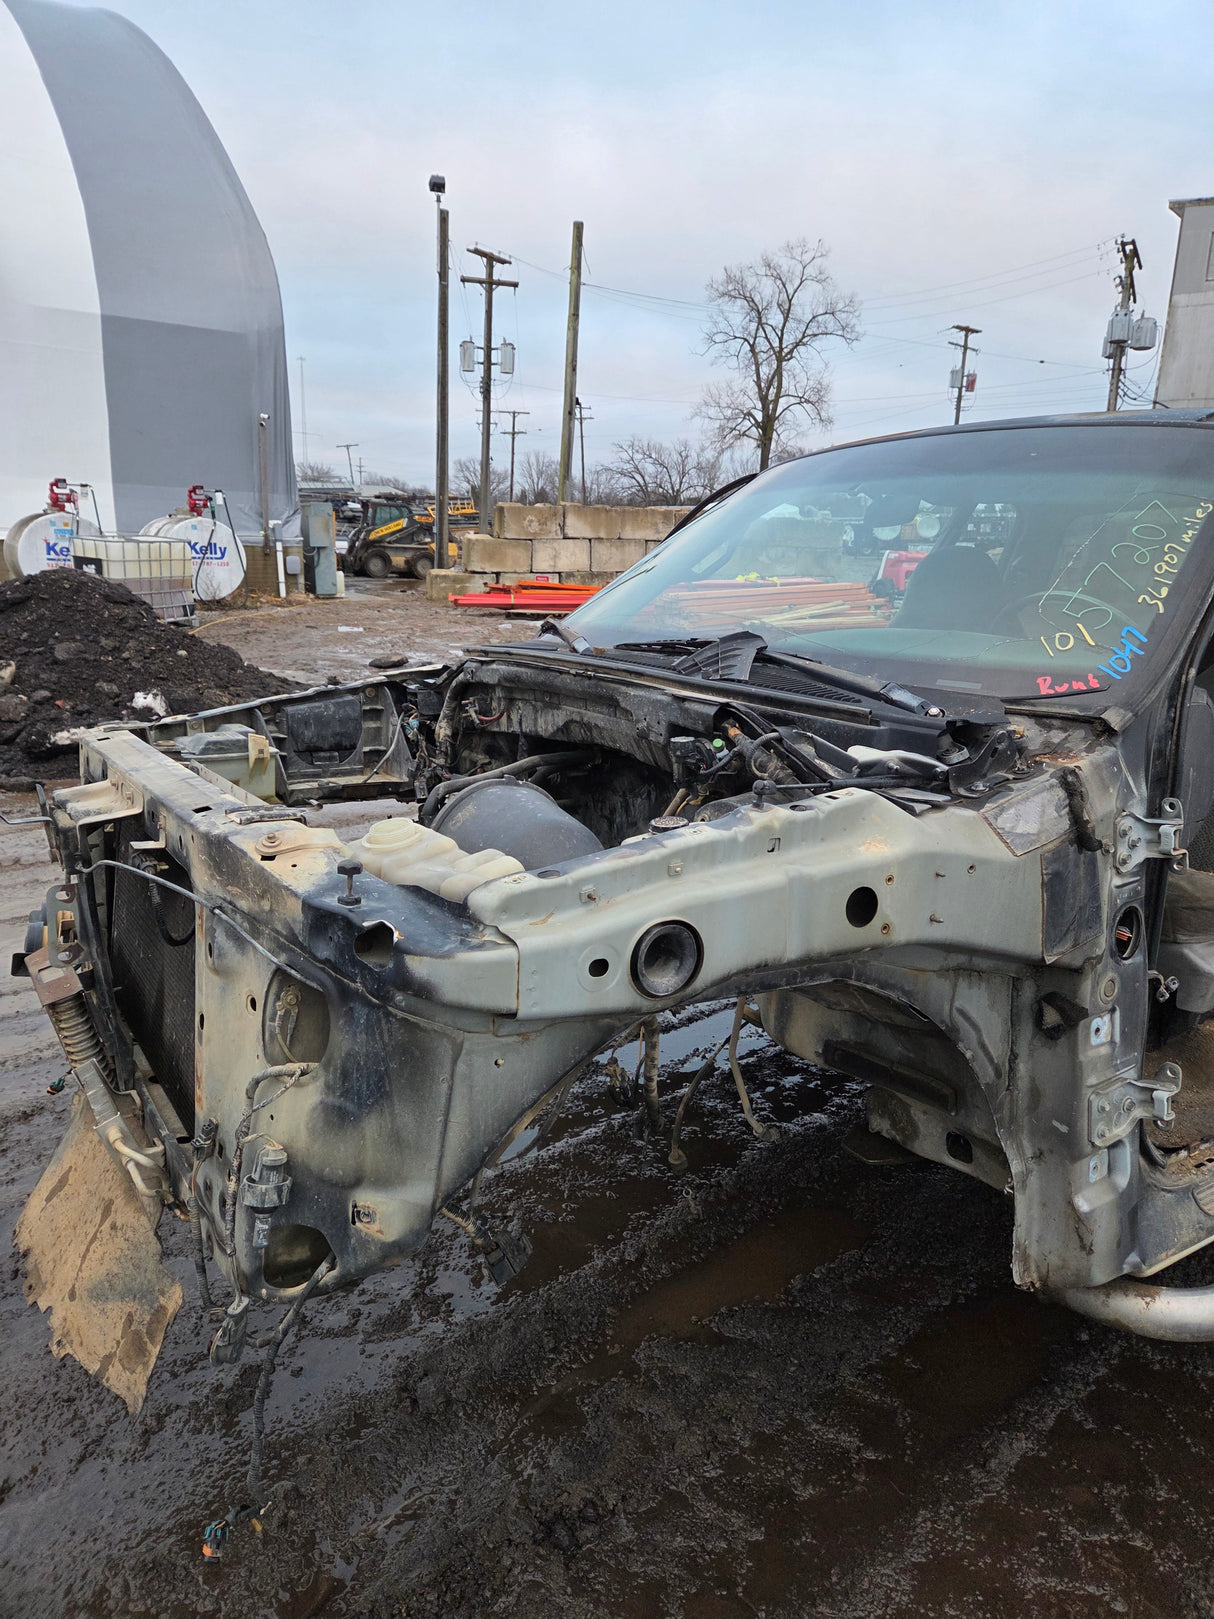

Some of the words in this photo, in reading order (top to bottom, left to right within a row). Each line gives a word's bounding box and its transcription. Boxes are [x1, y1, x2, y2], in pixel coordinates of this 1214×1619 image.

[188, 542, 227, 559] Kelly
[1062, 499, 1178, 630] 57207
[1137, 543, 1187, 614] 361907
[1181, 502, 1214, 543] miles
[1040, 623, 1096, 657] 101
[1097, 626, 1148, 680] 1047
